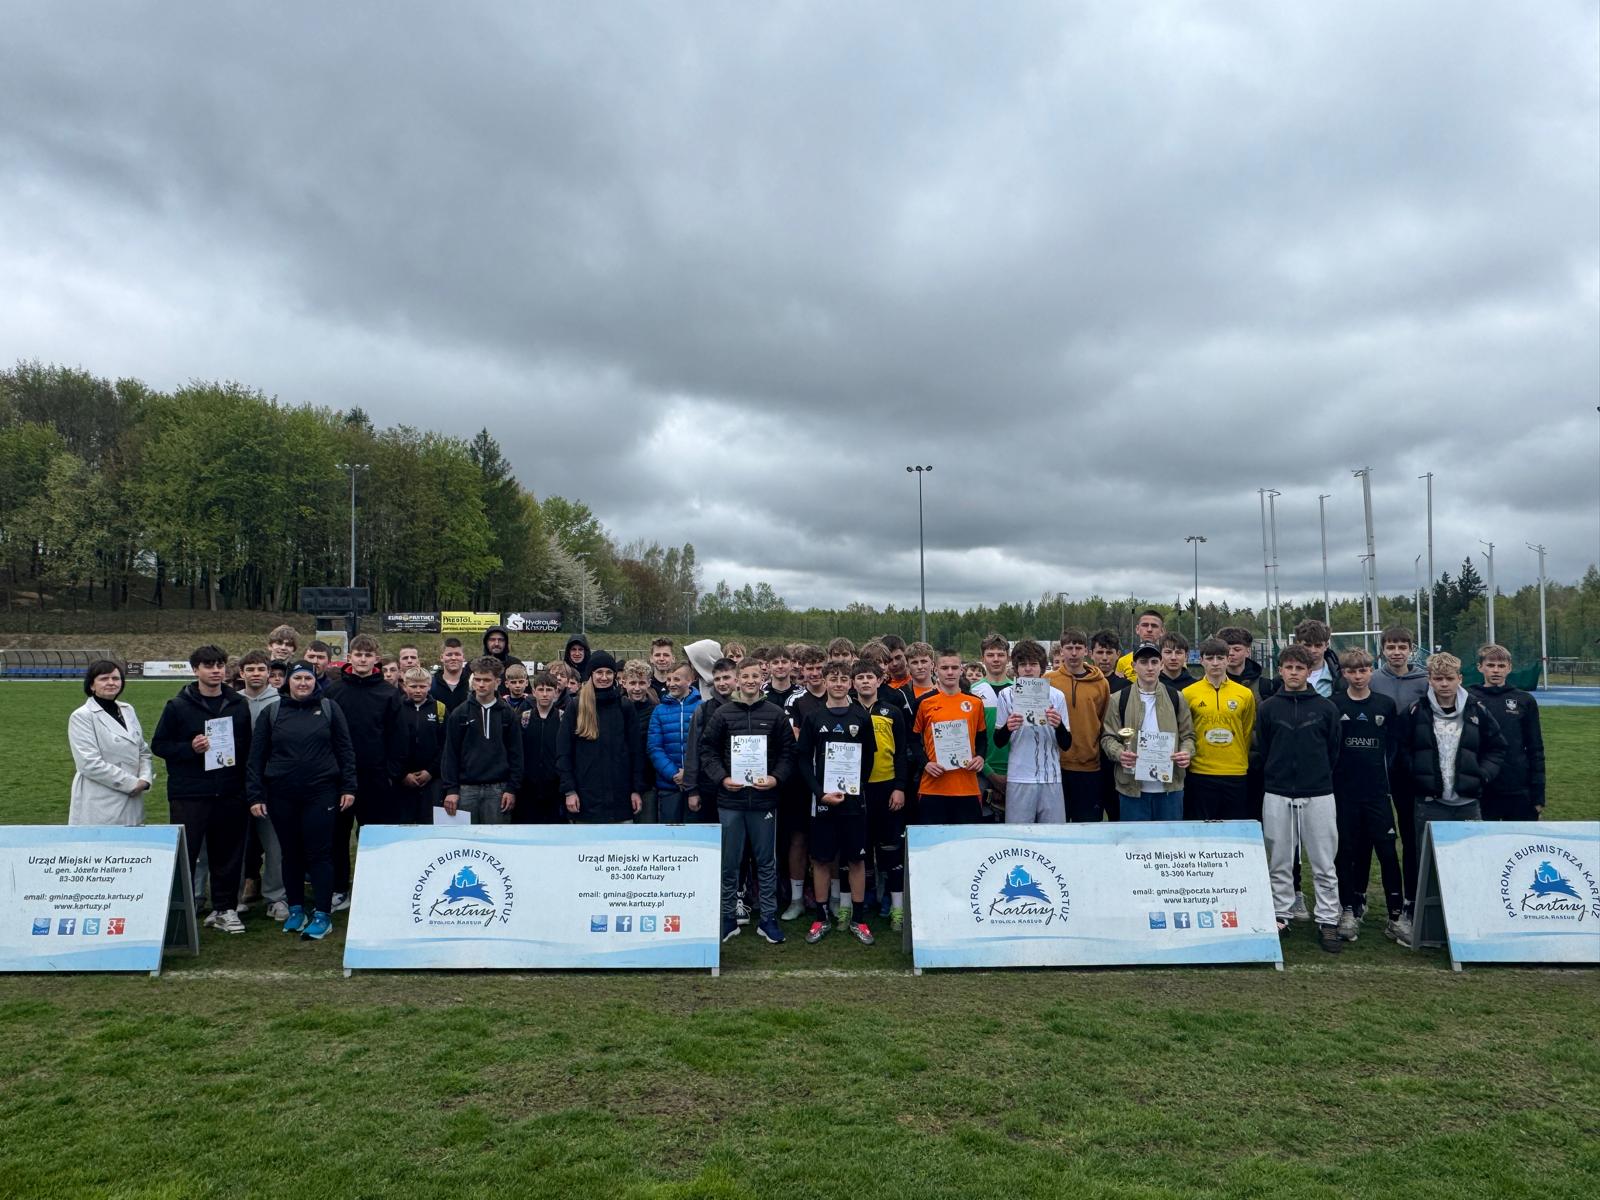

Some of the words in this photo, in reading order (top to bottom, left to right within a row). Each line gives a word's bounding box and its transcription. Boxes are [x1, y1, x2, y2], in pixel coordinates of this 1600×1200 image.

[28, 856, 56, 865] Urząd
[58, 856, 91, 866] Miejski
[578, 855, 604, 863] Urząd
[608, 855, 639, 864] Miejski
[1126, 852, 1151, 861] Urząd
[1155, 851, 1186, 861] Miejski
[412, 863, 436, 923] PATRONAT
[438, 849, 504, 875] BURMISTRZA
[499, 875, 513, 923] KARTUZ
[971, 863, 988, 923] PATRONAT
[988, 848, 1056, 874] BURMISTRZA
[1055, 874, 1070, 922] KARTUZ
[1501, 858, 1517, 918] PATRONAT
[1515, 845, 1583, 871] BURMISTRZA
[49, 893, 143, 902] gmina@poczta.kartuzy.pl
[1157, 887, 1247, 896] gmina@poczta.kartuzy.pl
[1164, 896, 1218, 904] www.kartuzy.pl
[429, 899, 497, 927] Kartuzy
[989, 898, 1057, 925] Kartuzy
[1521, 894, 1589, 921] Kartuzy
